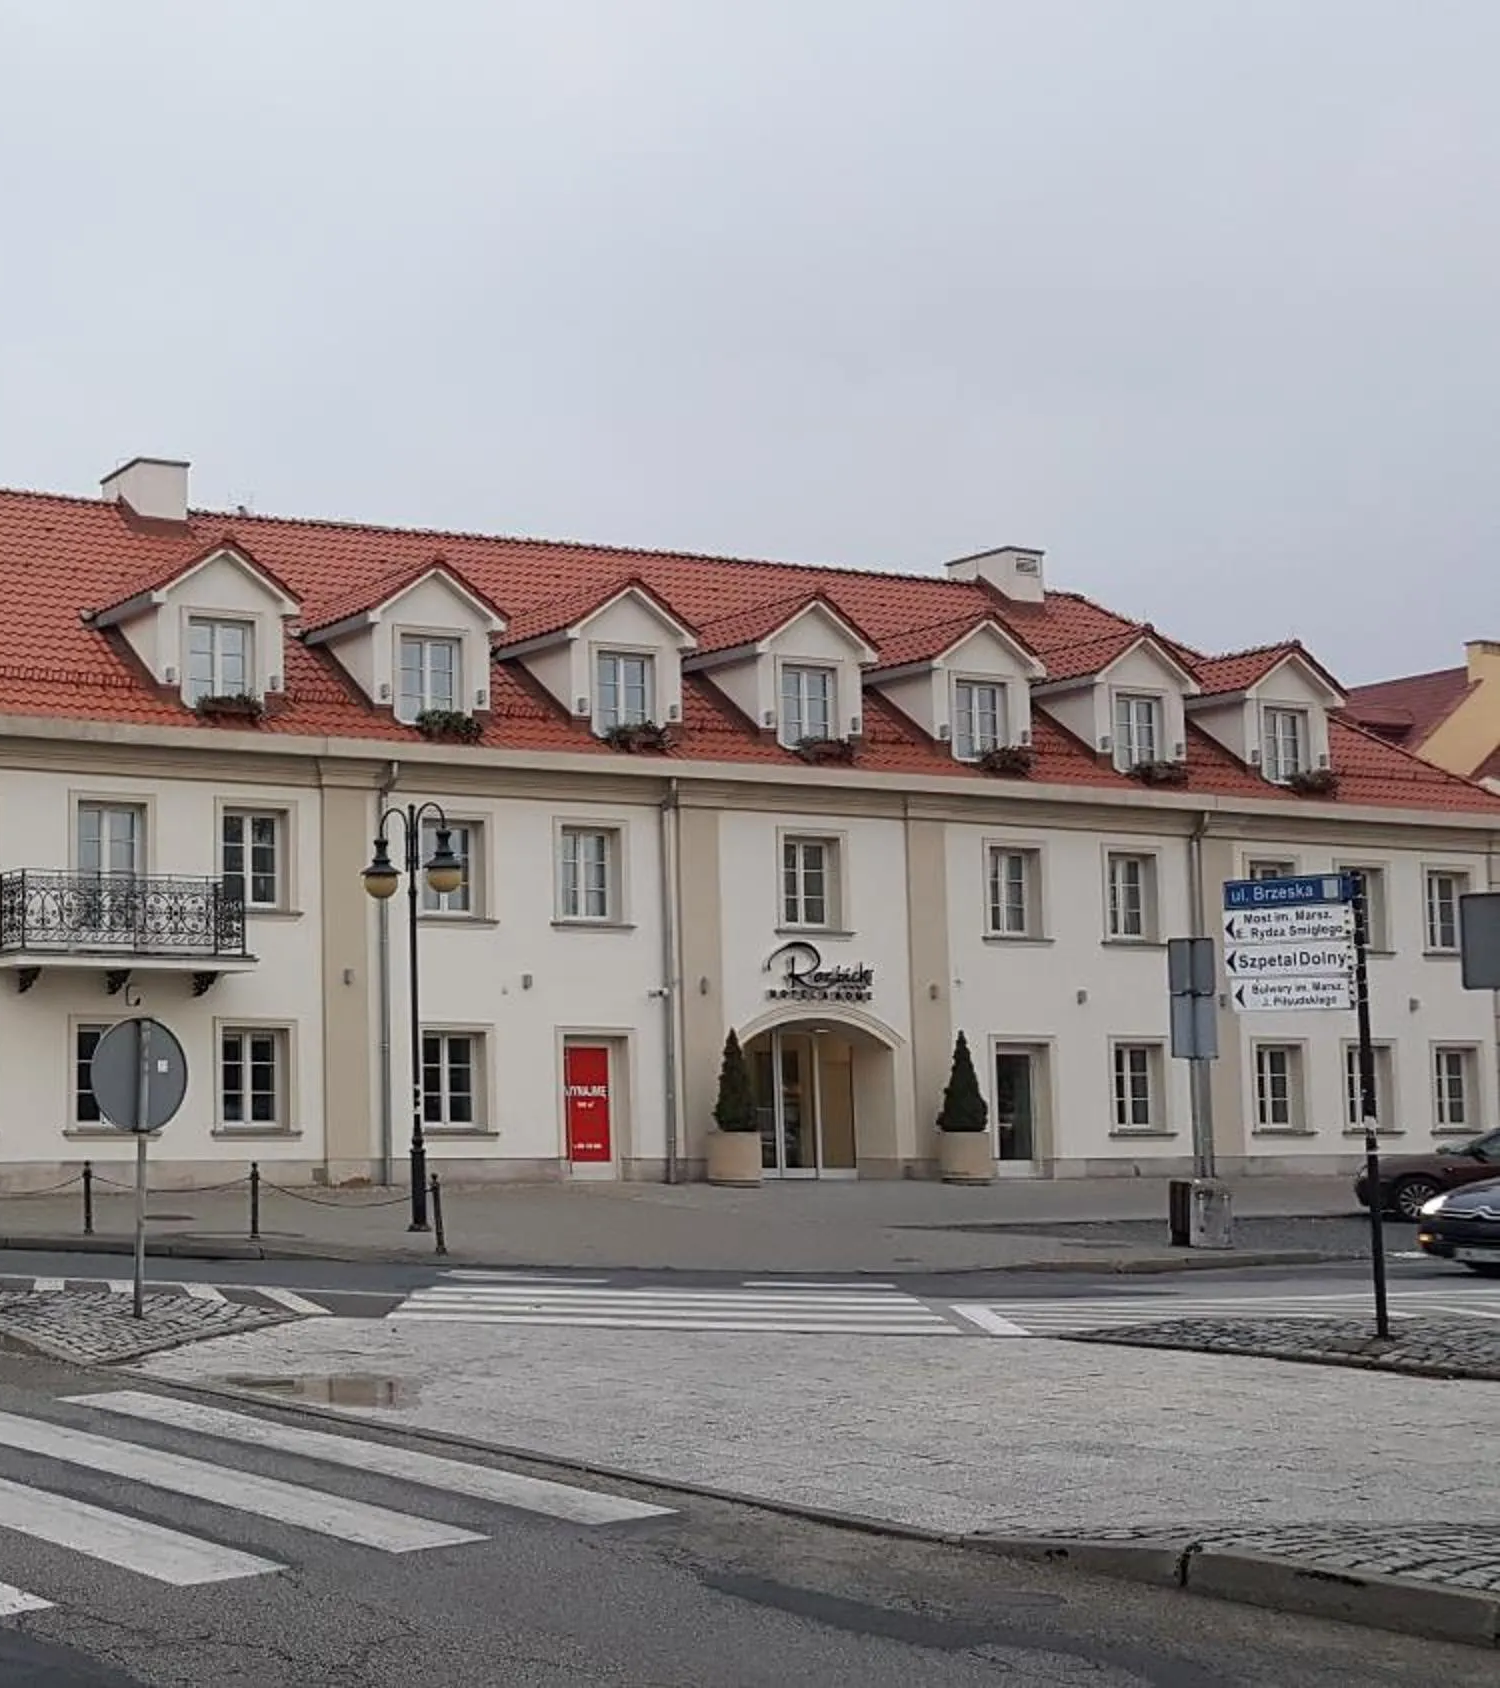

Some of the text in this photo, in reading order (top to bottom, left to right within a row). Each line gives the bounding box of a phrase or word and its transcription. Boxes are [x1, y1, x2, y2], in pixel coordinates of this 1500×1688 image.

[1231, 883, 1313, 902] ul. Brzeska
[1243, 912, 1271, 925] Most
[1238, 951, 1347, 970] Szpetal Dolny
